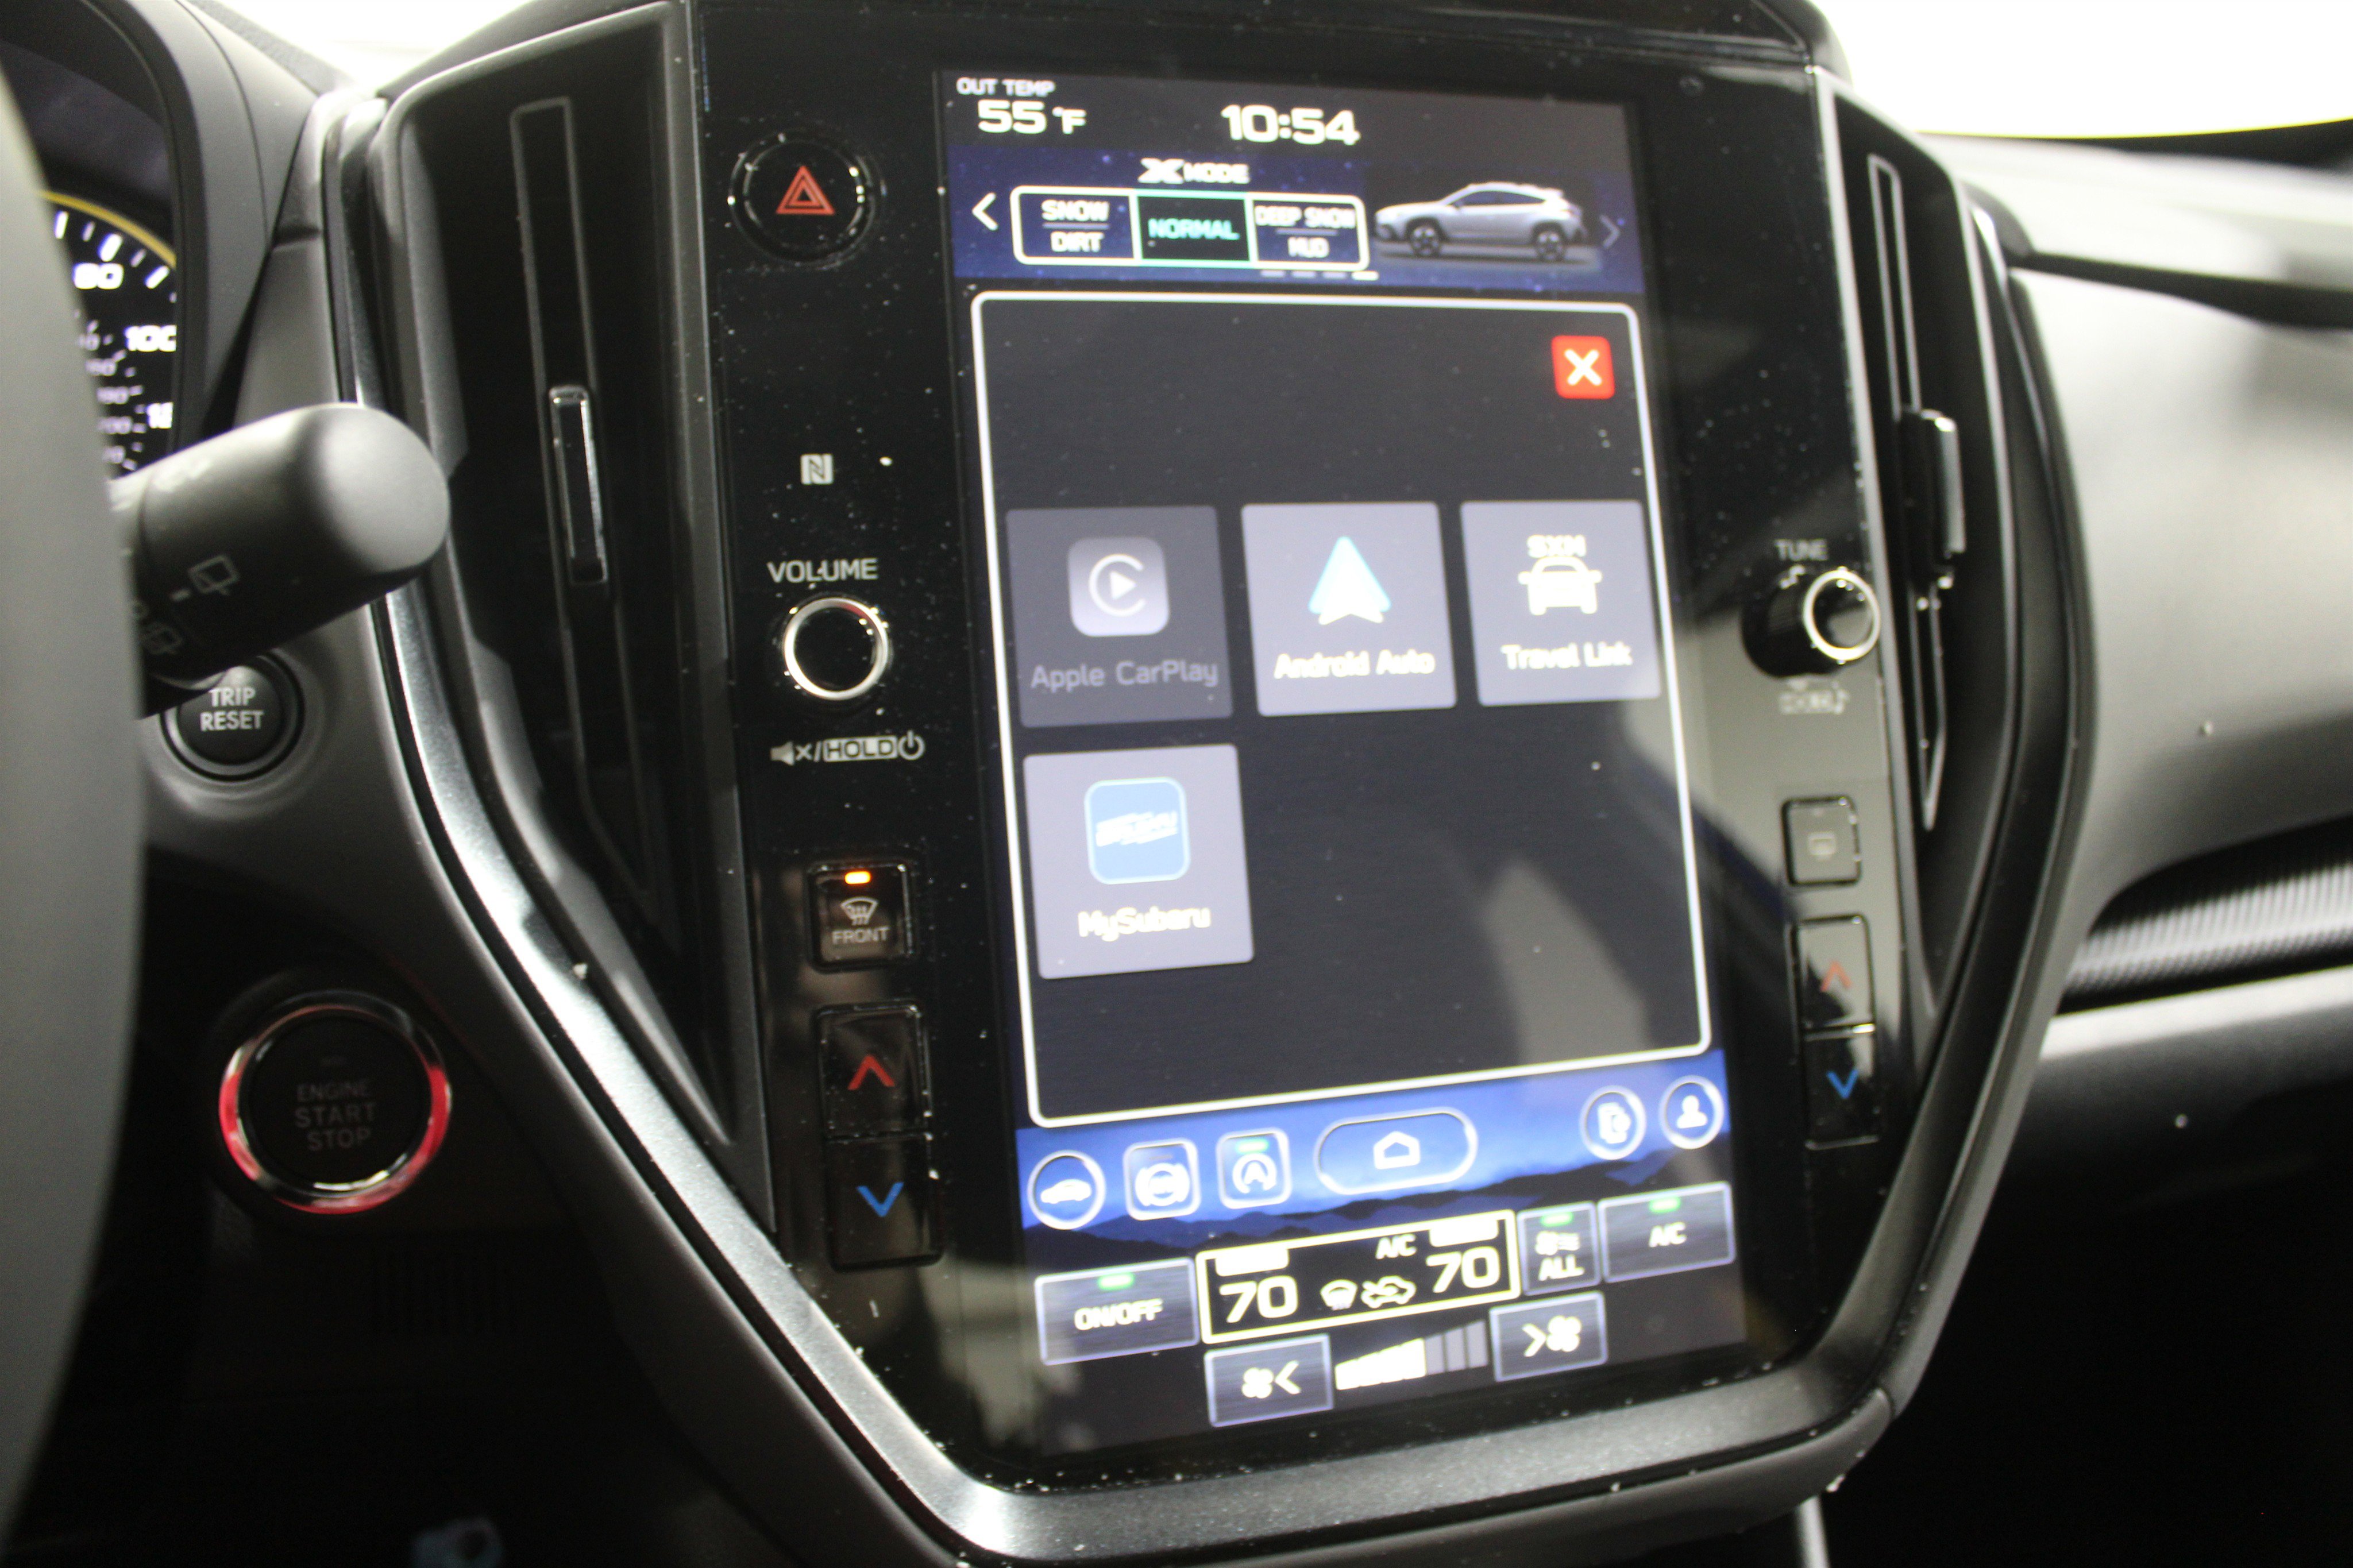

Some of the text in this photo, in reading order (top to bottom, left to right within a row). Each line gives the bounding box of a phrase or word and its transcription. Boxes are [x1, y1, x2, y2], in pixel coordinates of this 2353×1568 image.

[956, 78, 1054, 96] OUT TEMP
[977, 99, 1046, 133] 55
[1222, 103, 1360, 145] 10:54
[1042, 199, 1109, 222] SNOW
[1051, 231, 1104, 253] DIRT
[1149, 217, 1239, 241] NORMAL
[1775, 538, 1828, 561] TUNE
[767, 558, 878, 584] VOLUME
[1274, 649, 1435, 679] Android Auto
[1500, 641, 1633, 670] Travel Link
[1031, 659, 1218, 693] Apple CarPlay
[209, 688, 256, 708] TRIP
[200, 710, 264, 732] RESET
[832, 926, 890, 944] FRONT
[1078, 906, 1212, 942] MySubaru
[294, 1102, 376, 1129] START
[307, 1126, 372, 1152] STOP
[1375, 1234, 1417, 1260] A/C
[1648, 1222, 1687, 1248] A/C
[1425, 1246, 1500, 1293] 70
[1538, 1254, 1584, 1281] ALL
[1219, 1275, 1298, 1323] 70
[1074, 1298, 1163, 1331] ON/OFF
